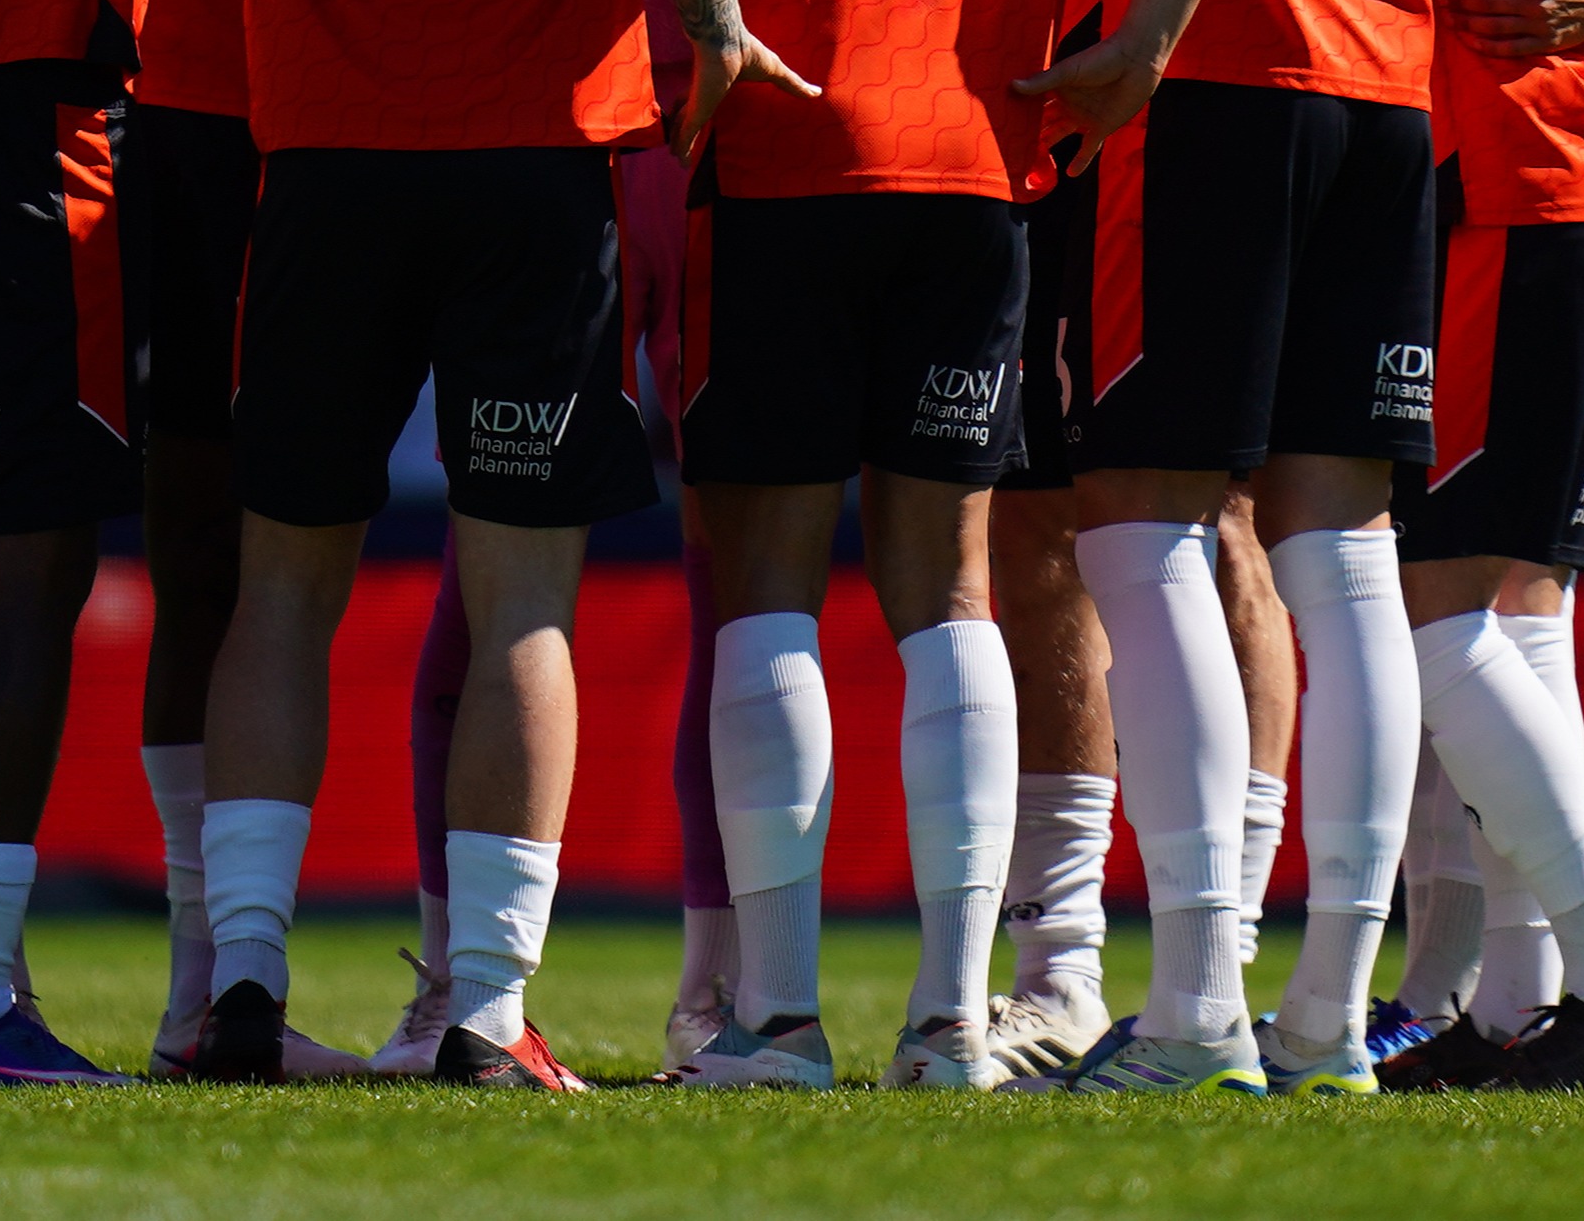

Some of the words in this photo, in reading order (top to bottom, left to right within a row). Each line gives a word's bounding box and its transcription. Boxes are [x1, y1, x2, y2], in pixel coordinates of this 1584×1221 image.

[917, 395, 988, 422] financial
[470, 430, 552, 456] financial
[910, 416, 990, 447] planning
[468, 452, 553, 482] planning
